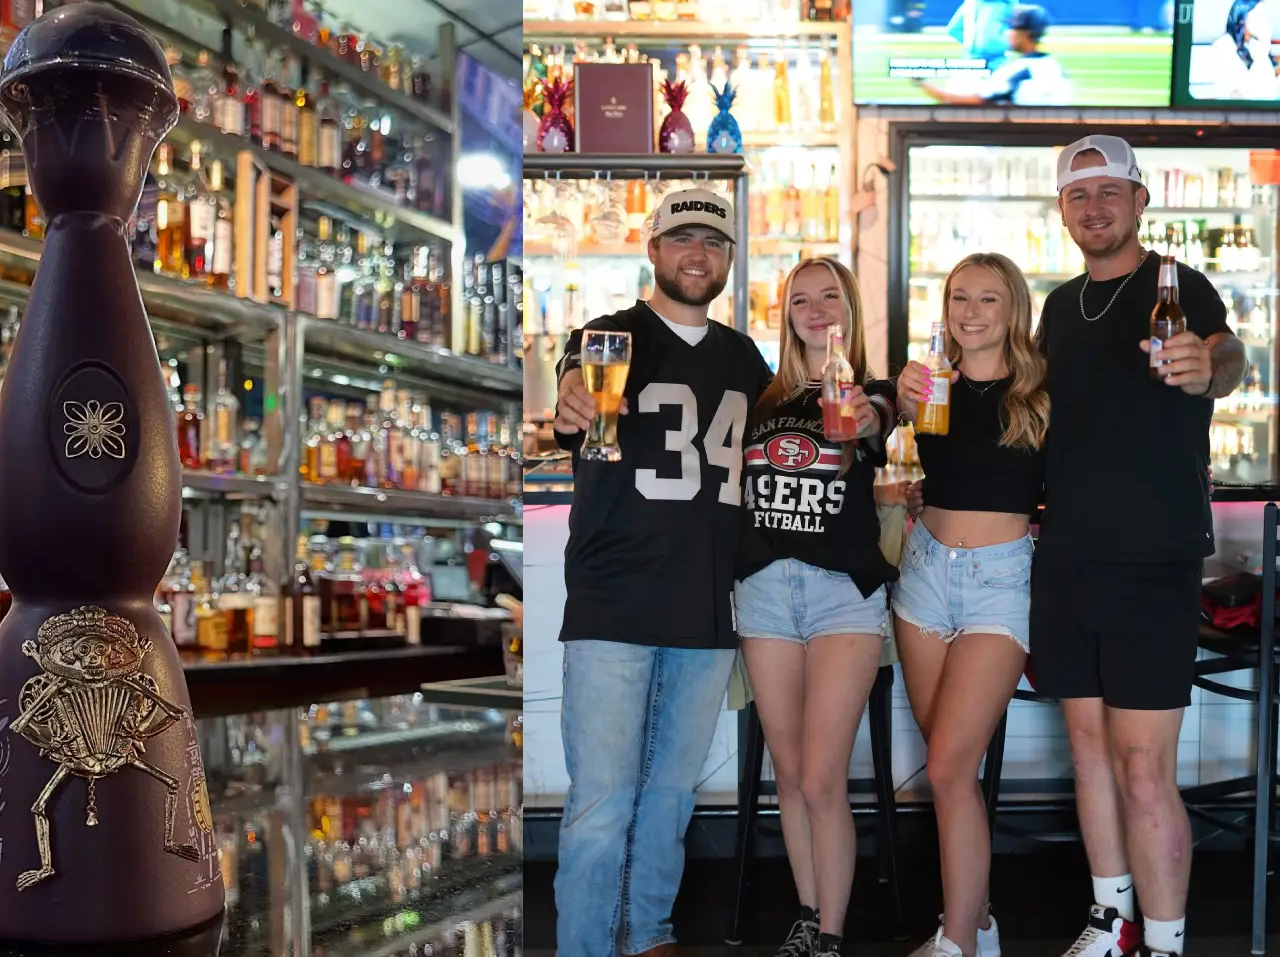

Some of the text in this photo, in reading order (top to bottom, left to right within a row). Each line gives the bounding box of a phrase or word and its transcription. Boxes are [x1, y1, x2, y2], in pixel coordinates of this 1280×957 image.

[670, 200, 727, 219] RAIDERS
[751, 419, 777, 440] SAN
[634, 382, 748, 507] 34
[777, 438, 809, 467] SF
[744, 473, 847, 515] 49ERS
